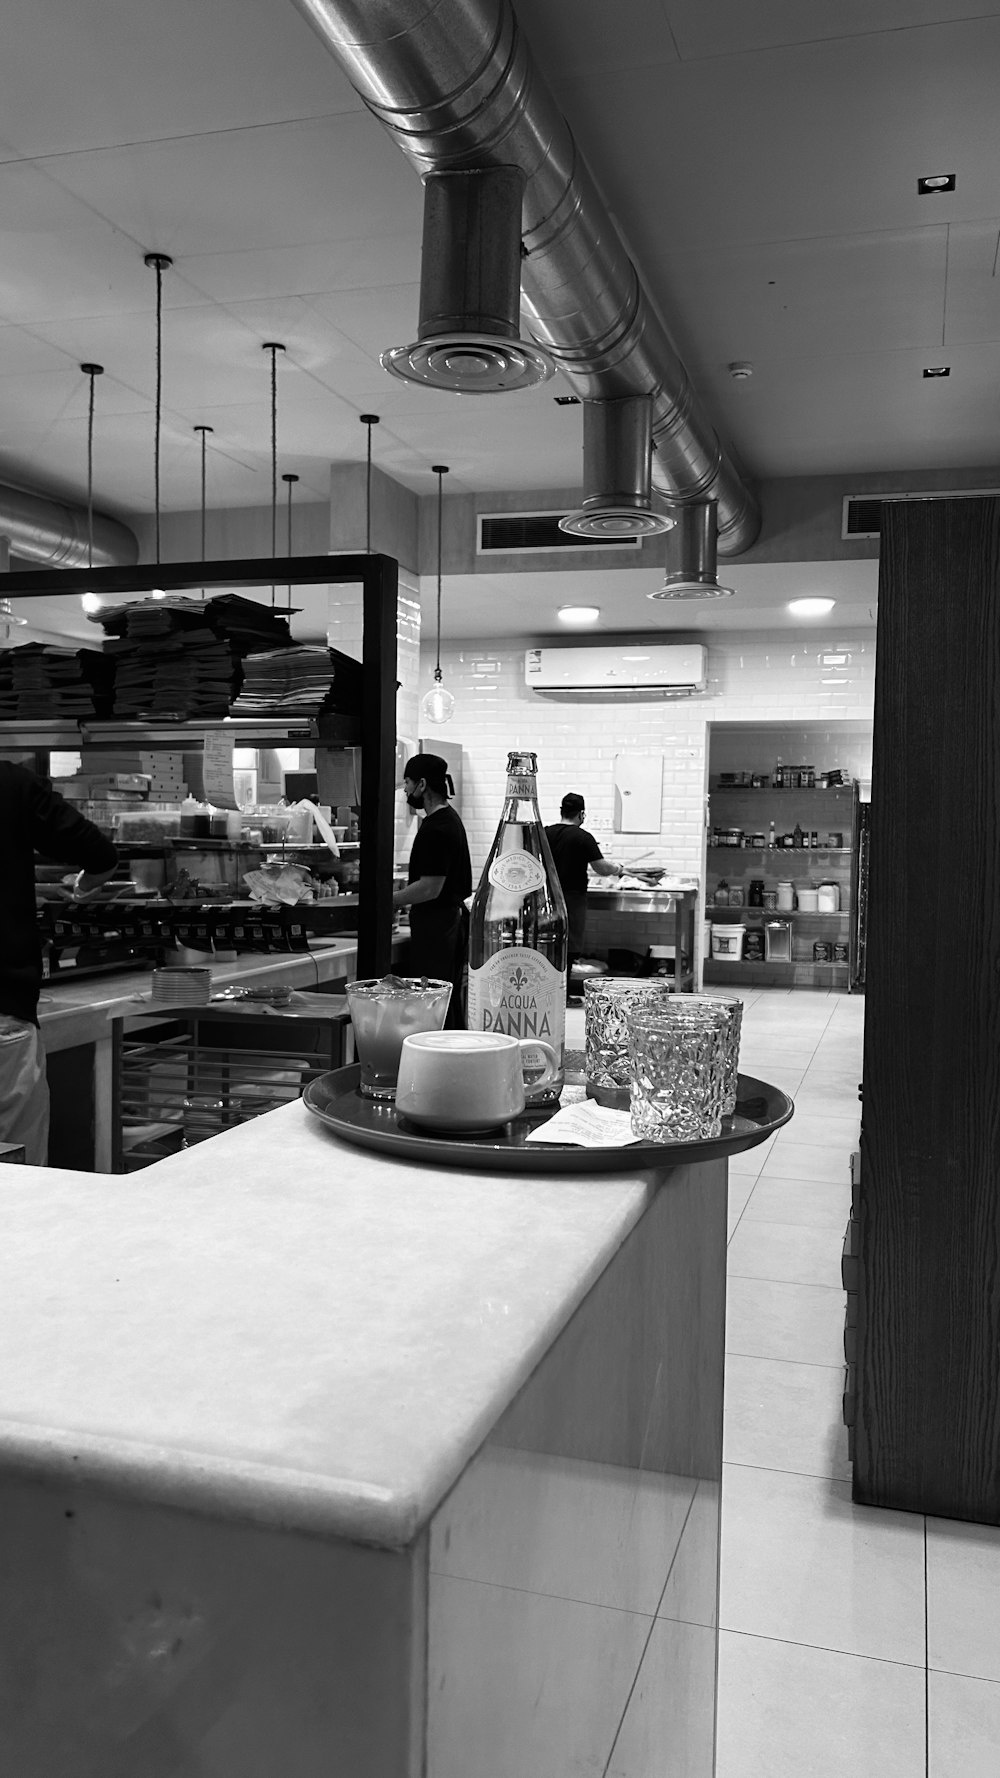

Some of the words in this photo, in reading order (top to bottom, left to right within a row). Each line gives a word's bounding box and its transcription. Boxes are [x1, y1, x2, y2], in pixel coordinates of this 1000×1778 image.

[509, 783, 535, 795] PANNA
[500, 995, 537, 1009] ACQUA
[483, 1009, 551, 1037] PANNA
